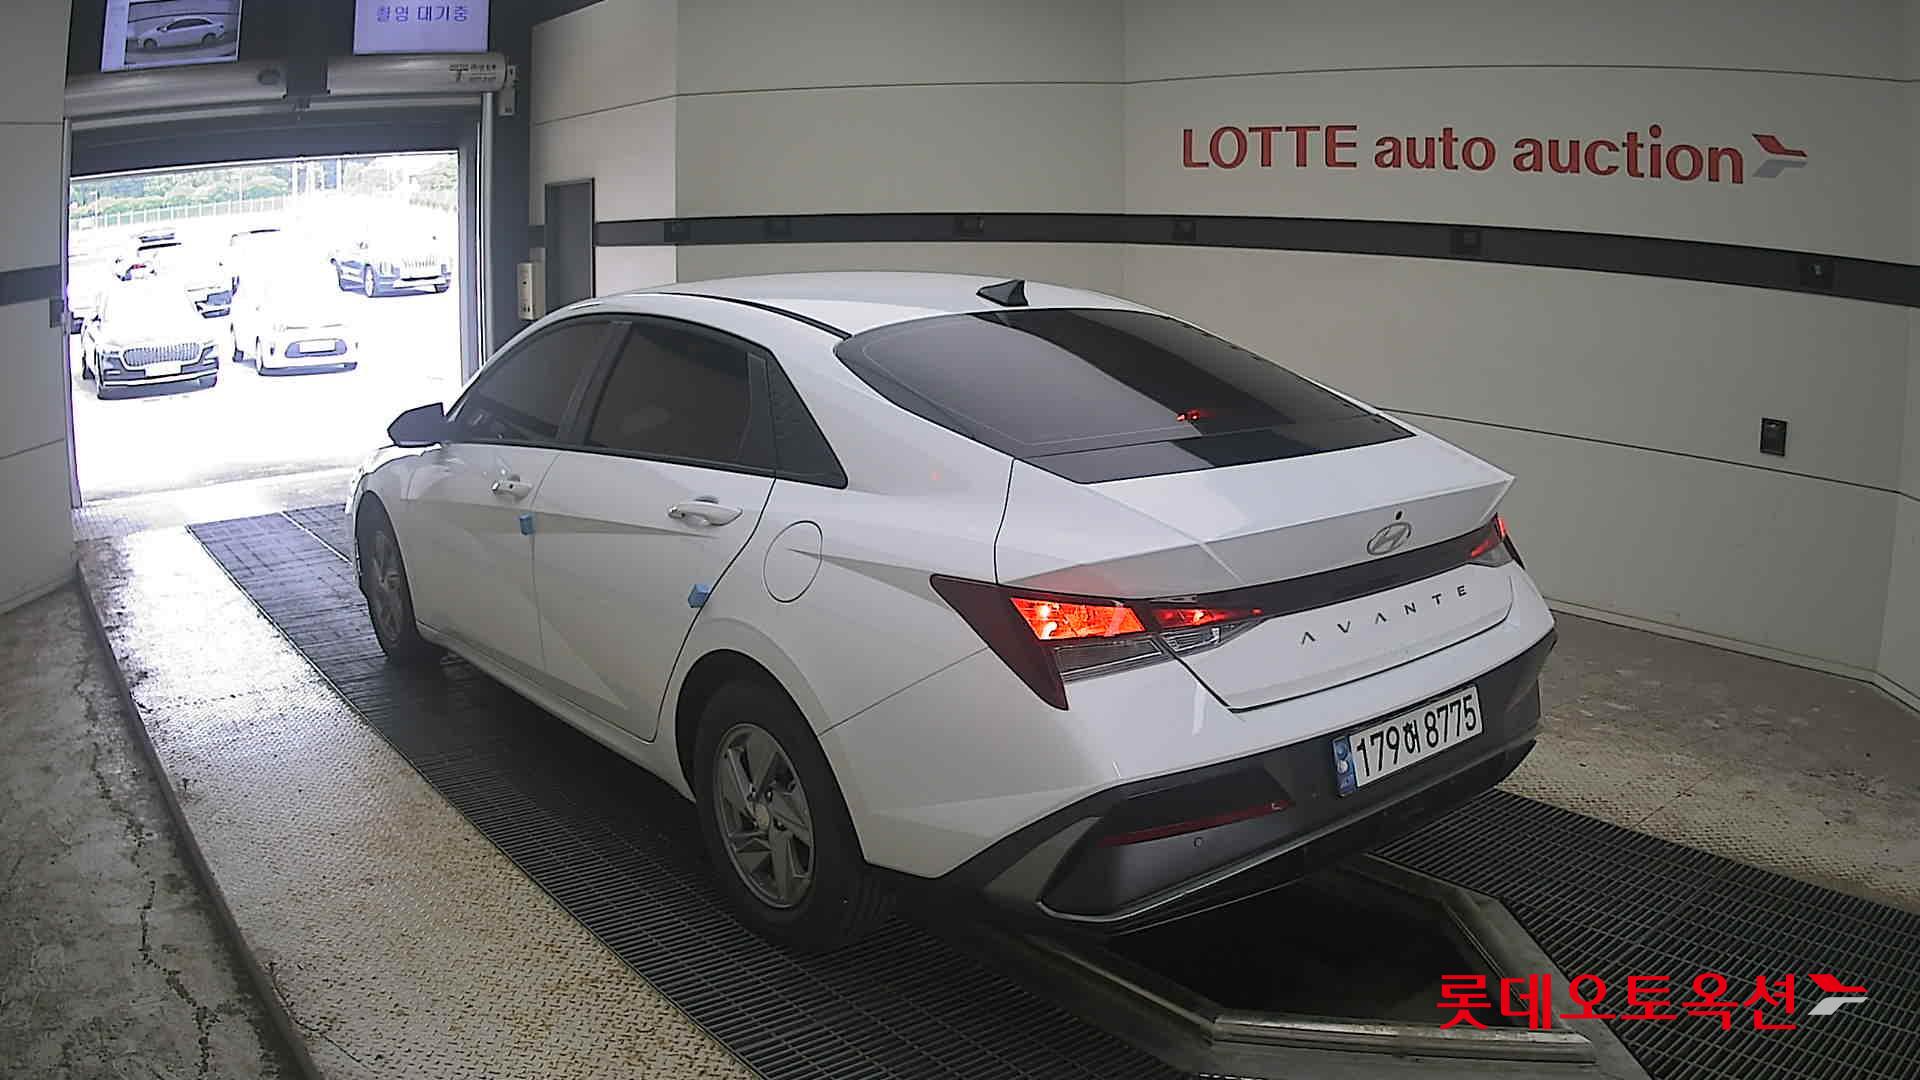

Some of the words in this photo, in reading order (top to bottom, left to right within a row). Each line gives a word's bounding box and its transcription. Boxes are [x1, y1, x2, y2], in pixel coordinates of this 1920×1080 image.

[416, 5, 468, 22] 대기중
[1183, 125, 1359, 169] LOTTE
[1374, 126, 1497, 170] auto
[1513, 125, 1744, 184] auction
[1301, 584, 1468, 645] AVANTE
